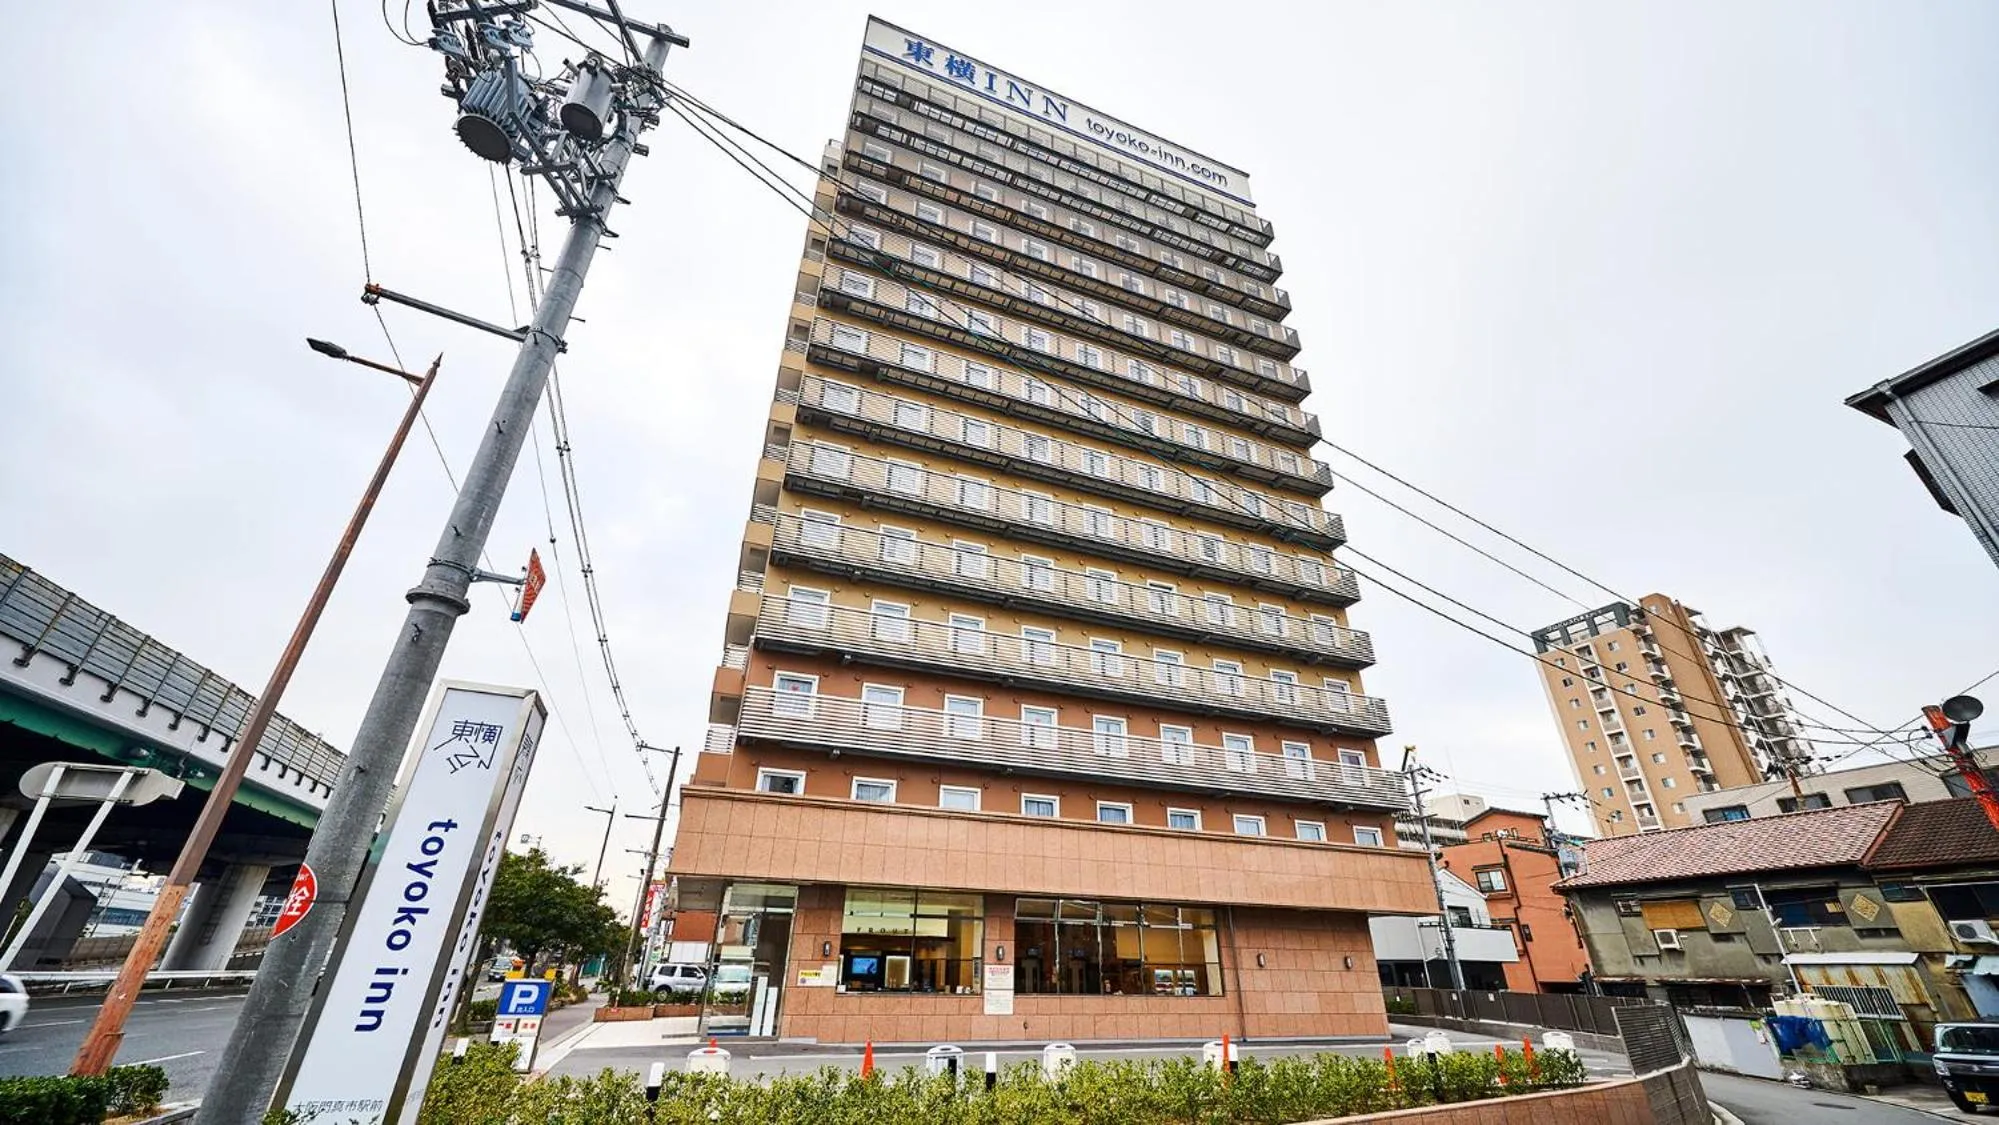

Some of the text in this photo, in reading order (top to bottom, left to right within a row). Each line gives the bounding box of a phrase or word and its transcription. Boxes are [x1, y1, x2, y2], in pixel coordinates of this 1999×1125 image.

[1086, 117, 1229, 187] toyoko-inn.com
[354, 818, 459, 1033] toyoko inn
[508, 984, 539, 1013] P
